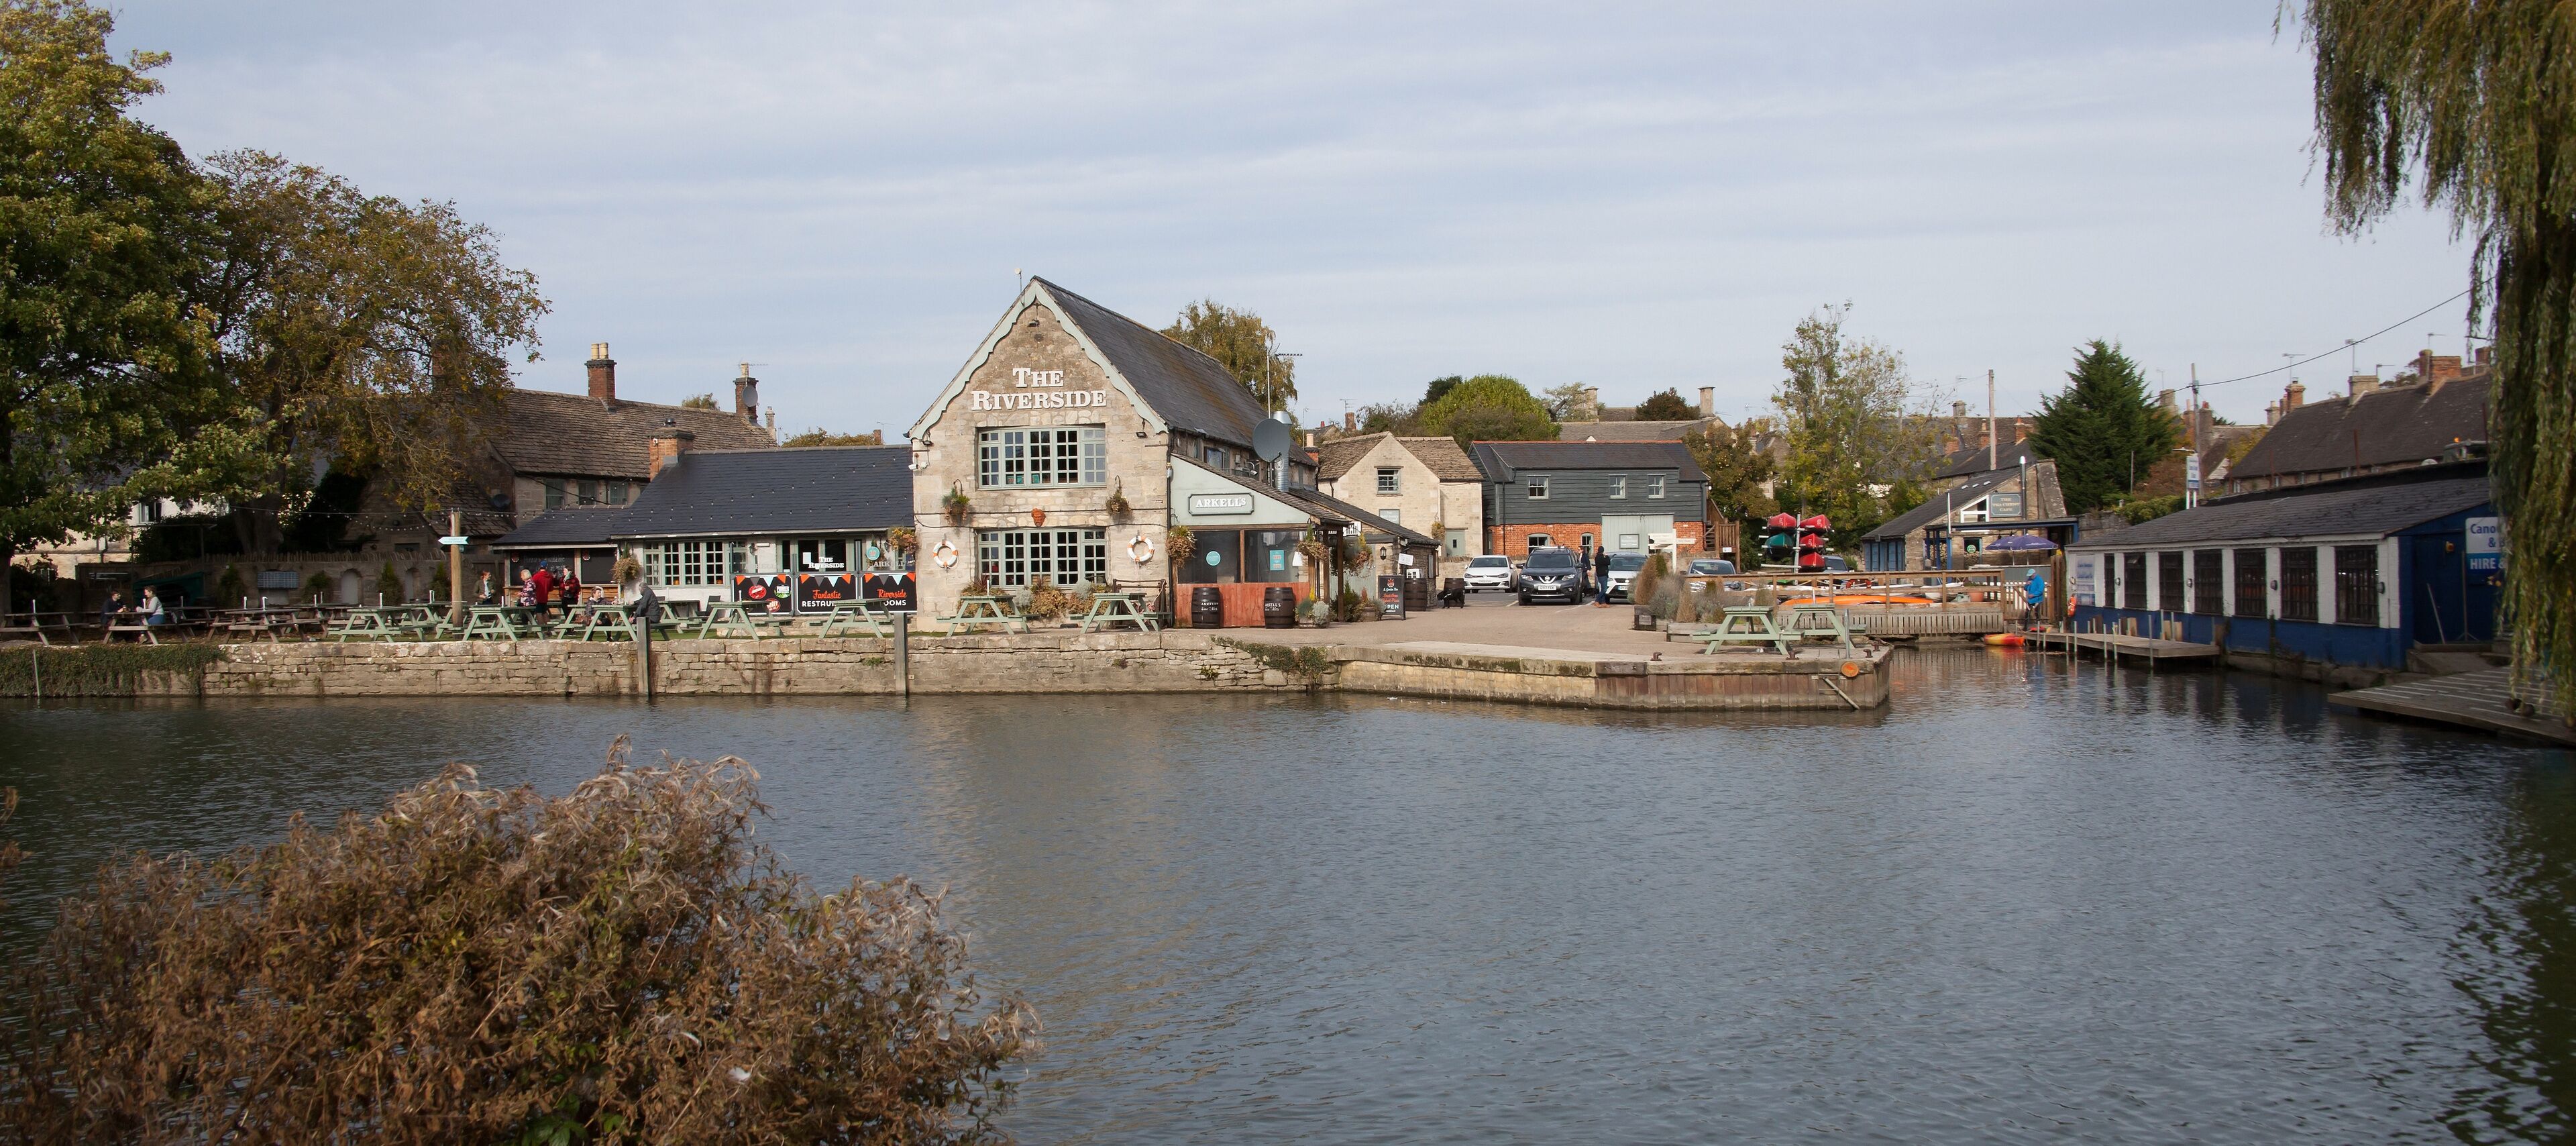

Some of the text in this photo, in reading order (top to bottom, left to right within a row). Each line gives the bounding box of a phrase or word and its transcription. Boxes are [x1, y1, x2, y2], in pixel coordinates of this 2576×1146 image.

[1012, 368, 1064, 388] THE
[971, 390, 1107, 411] RIVERSIDE
[1195, 497, 1247, 508] ARKELL'S
[2470, 523, 2499, 534] Cano
[2488, 537, 2496, 548] &
[2470, 558, 2497, 569] HIRE
[812, 589, 842, 600] Fantastic
[877, 588, 907, 598] Riverside
